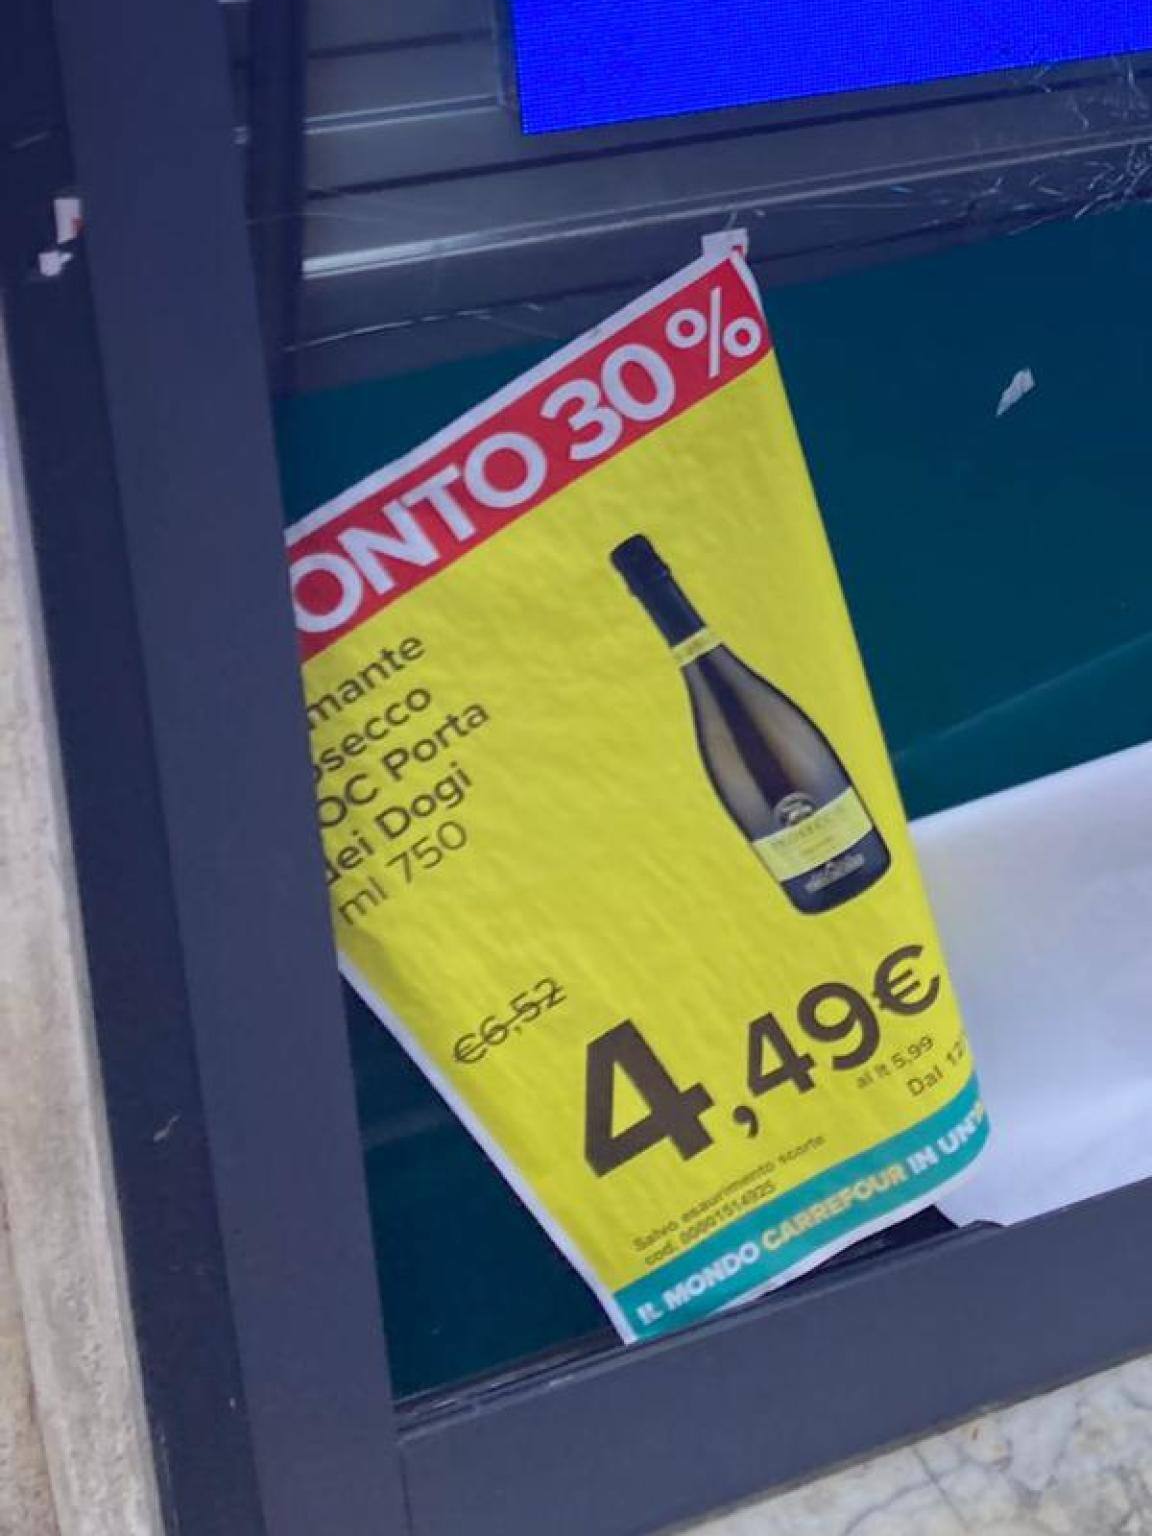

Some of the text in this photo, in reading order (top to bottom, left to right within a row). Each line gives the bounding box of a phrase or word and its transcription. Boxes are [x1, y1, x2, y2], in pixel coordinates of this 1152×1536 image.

[381, 703, 490, 782] Porta
[375, 761, 472, 840] Dogi
[338, 820, 467, 926] ml 750
[584, 944, 941, 1179] 4,49€
[906, 1065, 943, 1096] Dal
[632, 1221, 679, 1252] Salvo
[636, 1303, 664, 1326] IL
[662, 1242, 760, 1312] MONDO
[761, 1164, 909, 1252] CARREFOUR
[906, 1145, 939, 1176] IN
